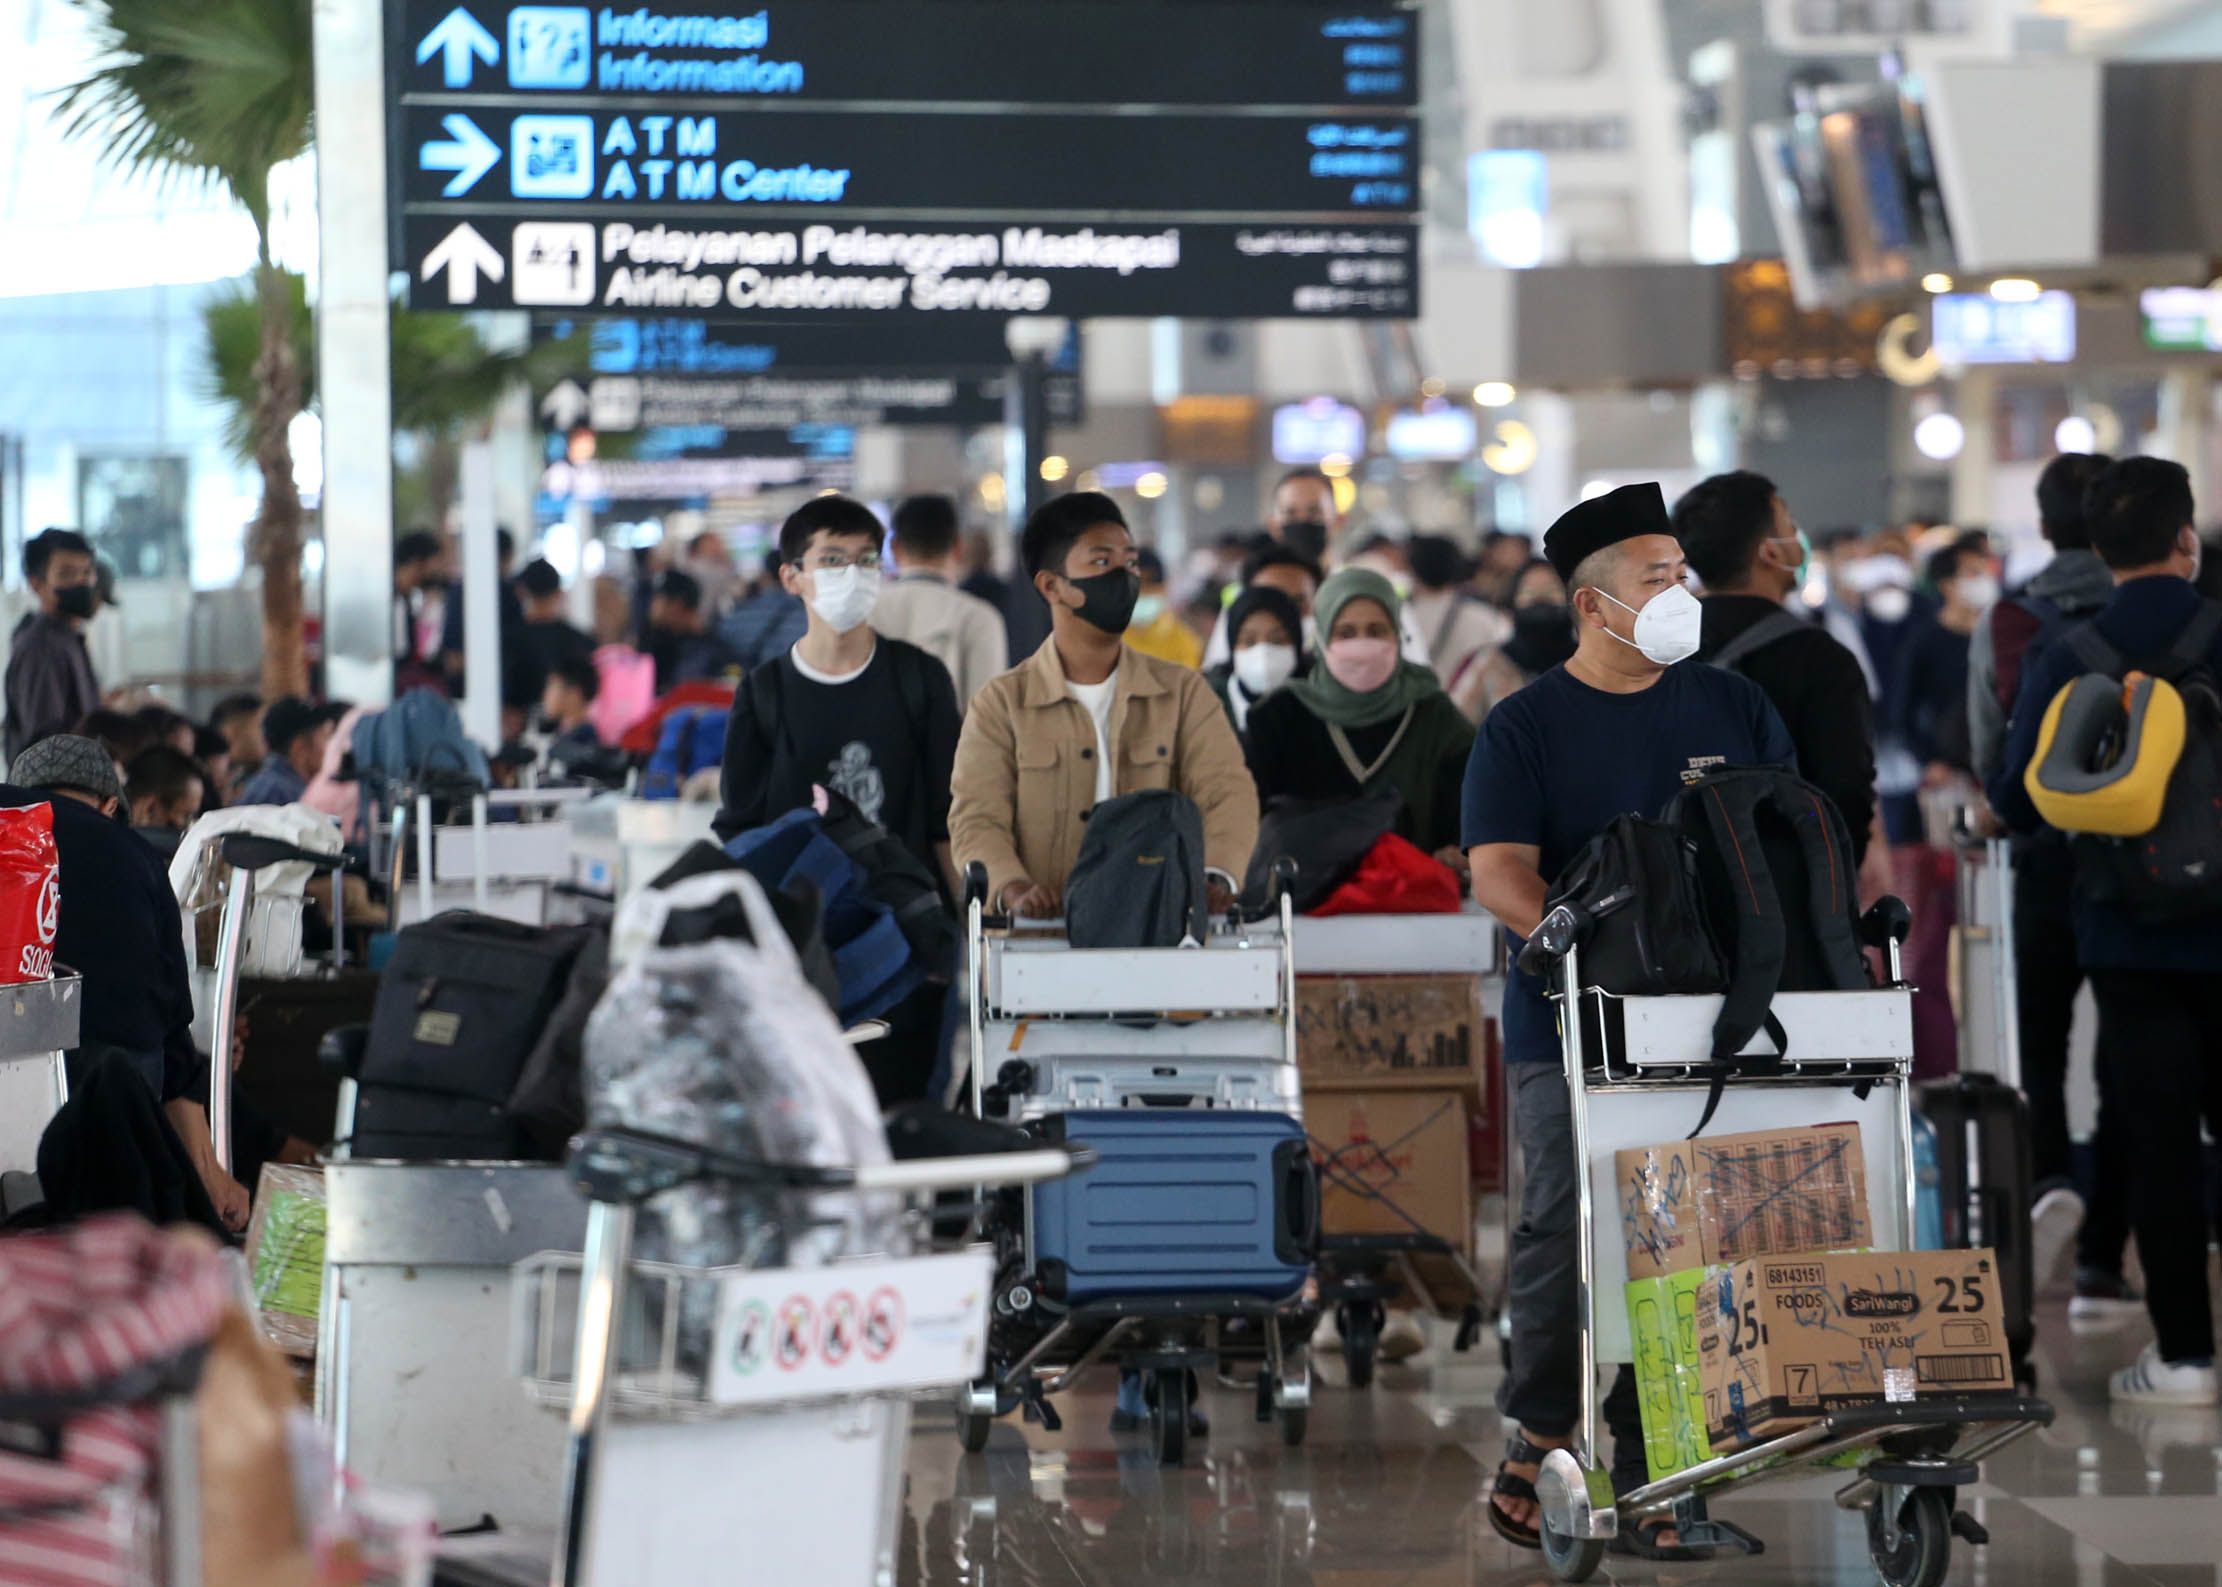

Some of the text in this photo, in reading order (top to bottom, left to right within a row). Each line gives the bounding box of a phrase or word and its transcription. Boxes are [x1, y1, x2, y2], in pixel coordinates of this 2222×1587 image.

[598, 9, 768, 48] Informasi
[598, 53, 803, 92] Information
[721, 160, 850, 201] Center
[603, 223, 797, 272] Pelayanan
[803, 226, 998, 275] Pelanggan
[1003, 227, 1179, 276] Maskapai
[604, 266, 1050, 310] Airline Customer Service
[1769, 1268, 1822, 1283] 68143151
[1934, 1276, 1985, 1313] 25
[1776, 1294, 1824, 1309] FOODS
[1728, 1300, 1759, 1357] 25
[1859, 1337, 1886, 1350] TEH
[1869, 1321, 1901, 1334] 100%
[1792, 1369, 1808, 1394] 7
